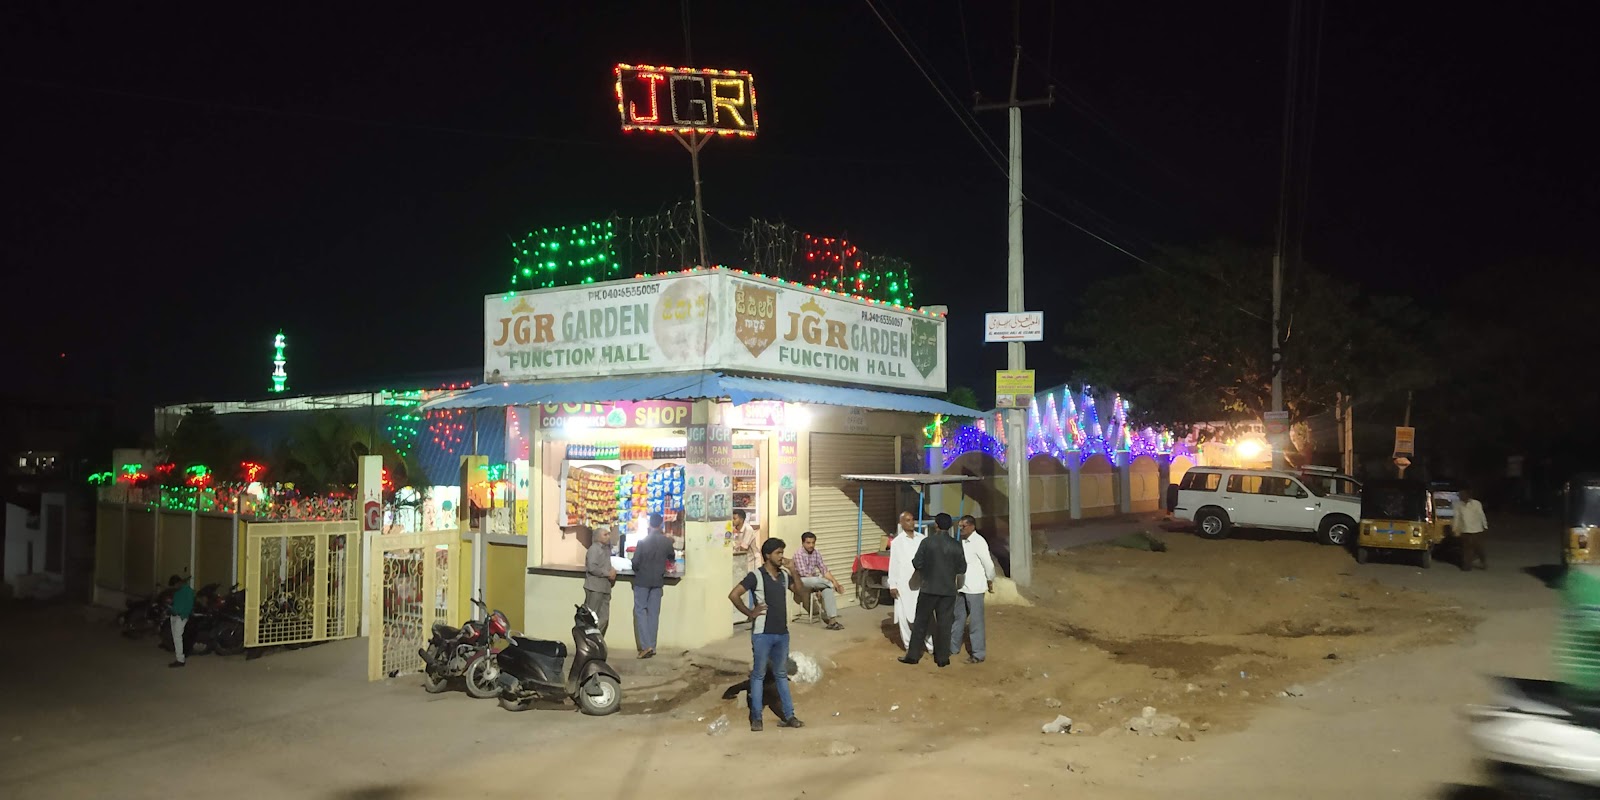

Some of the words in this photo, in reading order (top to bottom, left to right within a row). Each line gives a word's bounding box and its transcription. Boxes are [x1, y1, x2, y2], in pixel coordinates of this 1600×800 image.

[630, 72, 746, 126] JGR
[492, 313, 556, 347] JGR
[561, 303, 650, 342] GARDEN
[783, 311, 849, 350] JGR
[850, 323, 909, 358] GARDEN
[509, 347, 596, 369] FUNCTION
[601, 343, 650, 364] HALL
[779, 345, 859, 373] FUNCTION
[866, 359, 906, 378] HALL
[635, 406, 688, 426] SHOP
[687, 427, 705, 441] JGR
[709, 427, 731, 442] JGR
[780, 430, 797, 442] JGR
[689, 445, 704, 455] PAN
[712, 446, 729, 455] PAN
[782, 445, 795, 455] PAN
[709, 457, 732, 466] SHOP
